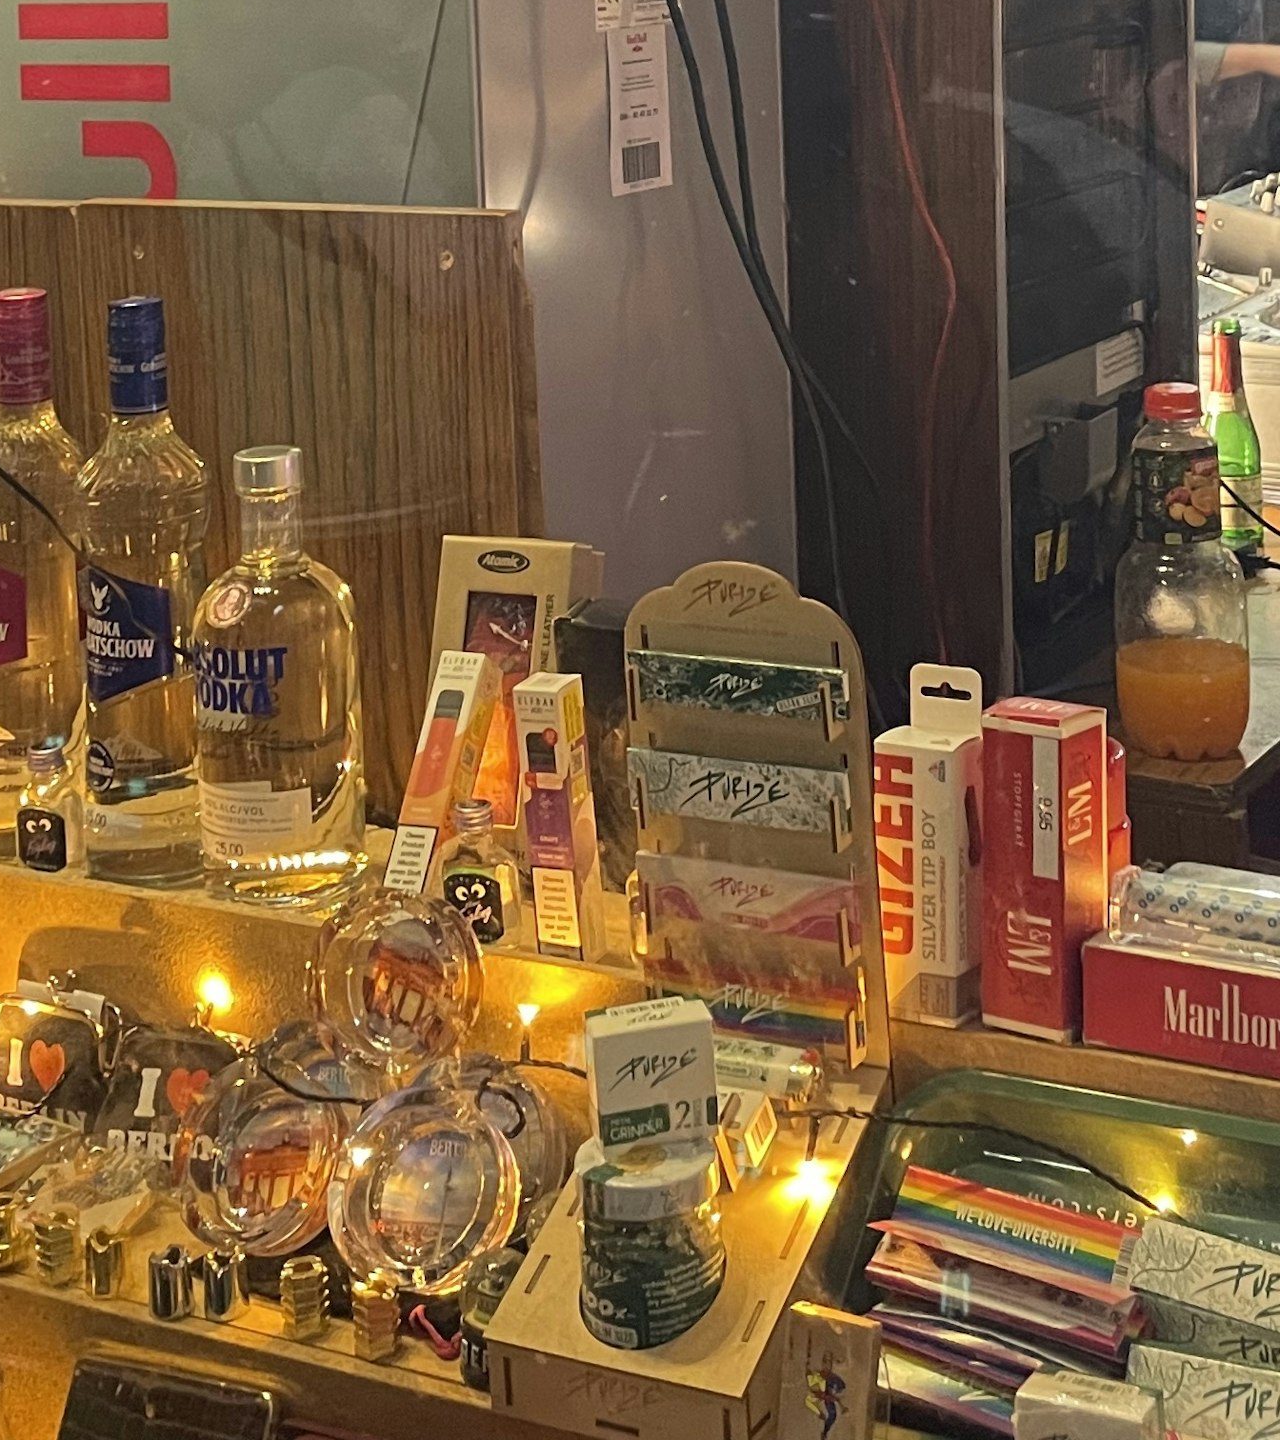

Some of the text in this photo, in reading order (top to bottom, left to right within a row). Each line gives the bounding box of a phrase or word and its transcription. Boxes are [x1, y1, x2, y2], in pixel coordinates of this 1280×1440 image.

[541, 593, 556, 647] LEATHER
[196, 645, 288, 681] SOLUT
[197, 677, 273, 716] ODKA
[1066, 779, 1094, 847] L&M
[873, 751, 915, 956] GIZEH
[920, 807, 937, 961] SILVER TIP BOY
[6, 1037, 24, 1087] I
[133, 1067, 162, 1118] I
[955, 1203, 1079, 1256] WE LOVE DIVERSITY
